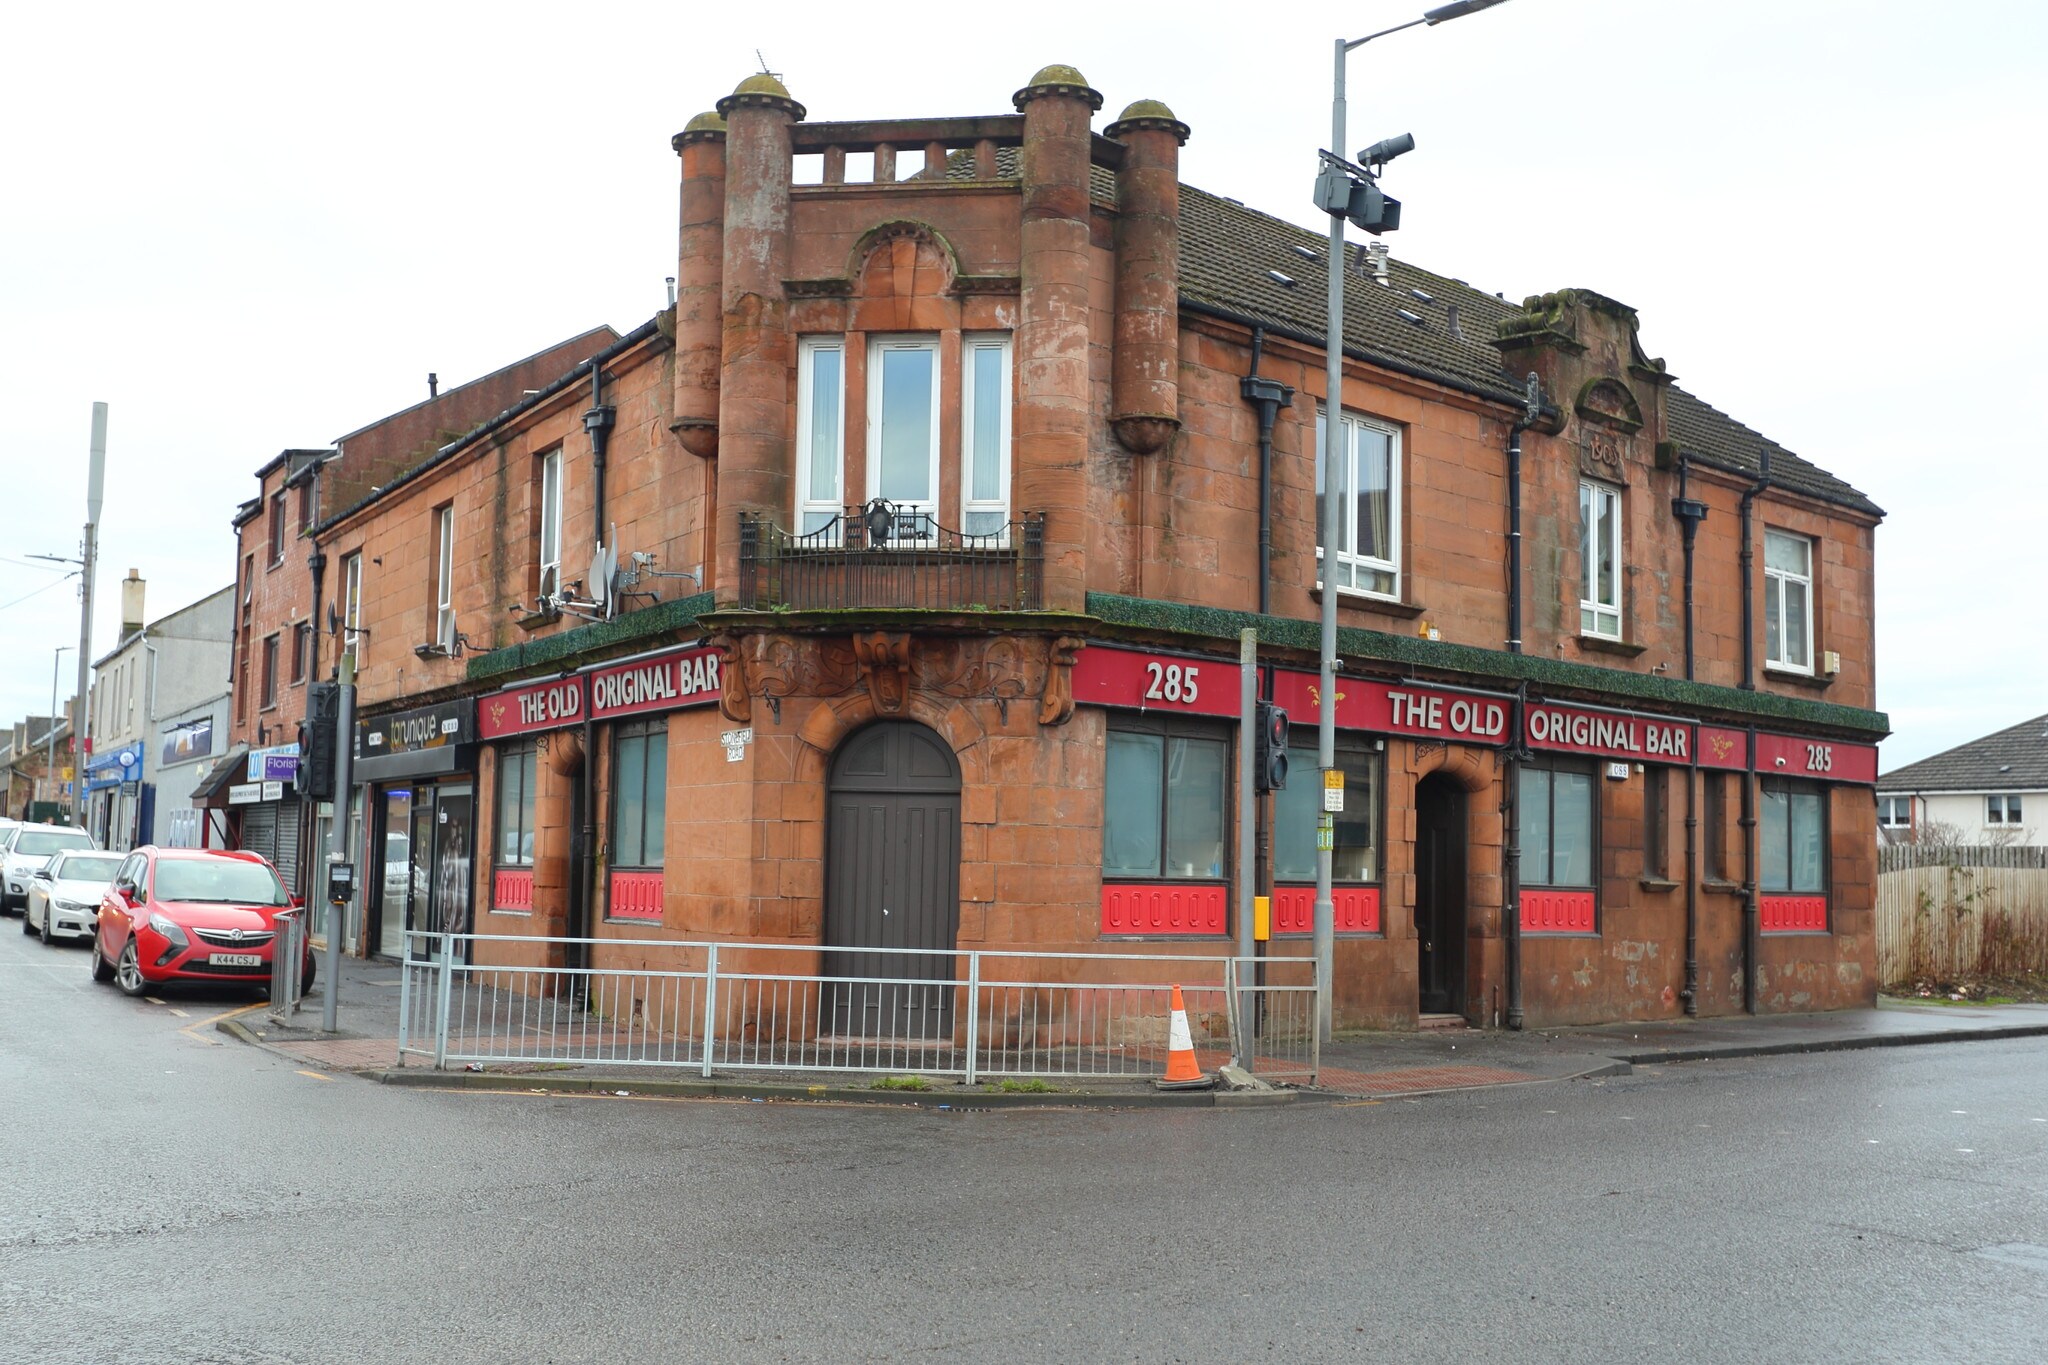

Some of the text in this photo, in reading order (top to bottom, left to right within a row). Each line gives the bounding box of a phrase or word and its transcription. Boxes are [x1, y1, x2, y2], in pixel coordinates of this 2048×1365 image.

[518, 653, 720, 725] THE OLD ORIGINAL BAR
[1146, 662, 1199, 703] 285
[1388, 691, 1687, 757] THE OLD ORIGINAL BAR
[267, 757, 297, 769] Florist
[1807, 744, 1832, 772] 285
[216, 955, 255, 965] K44 CSJ
